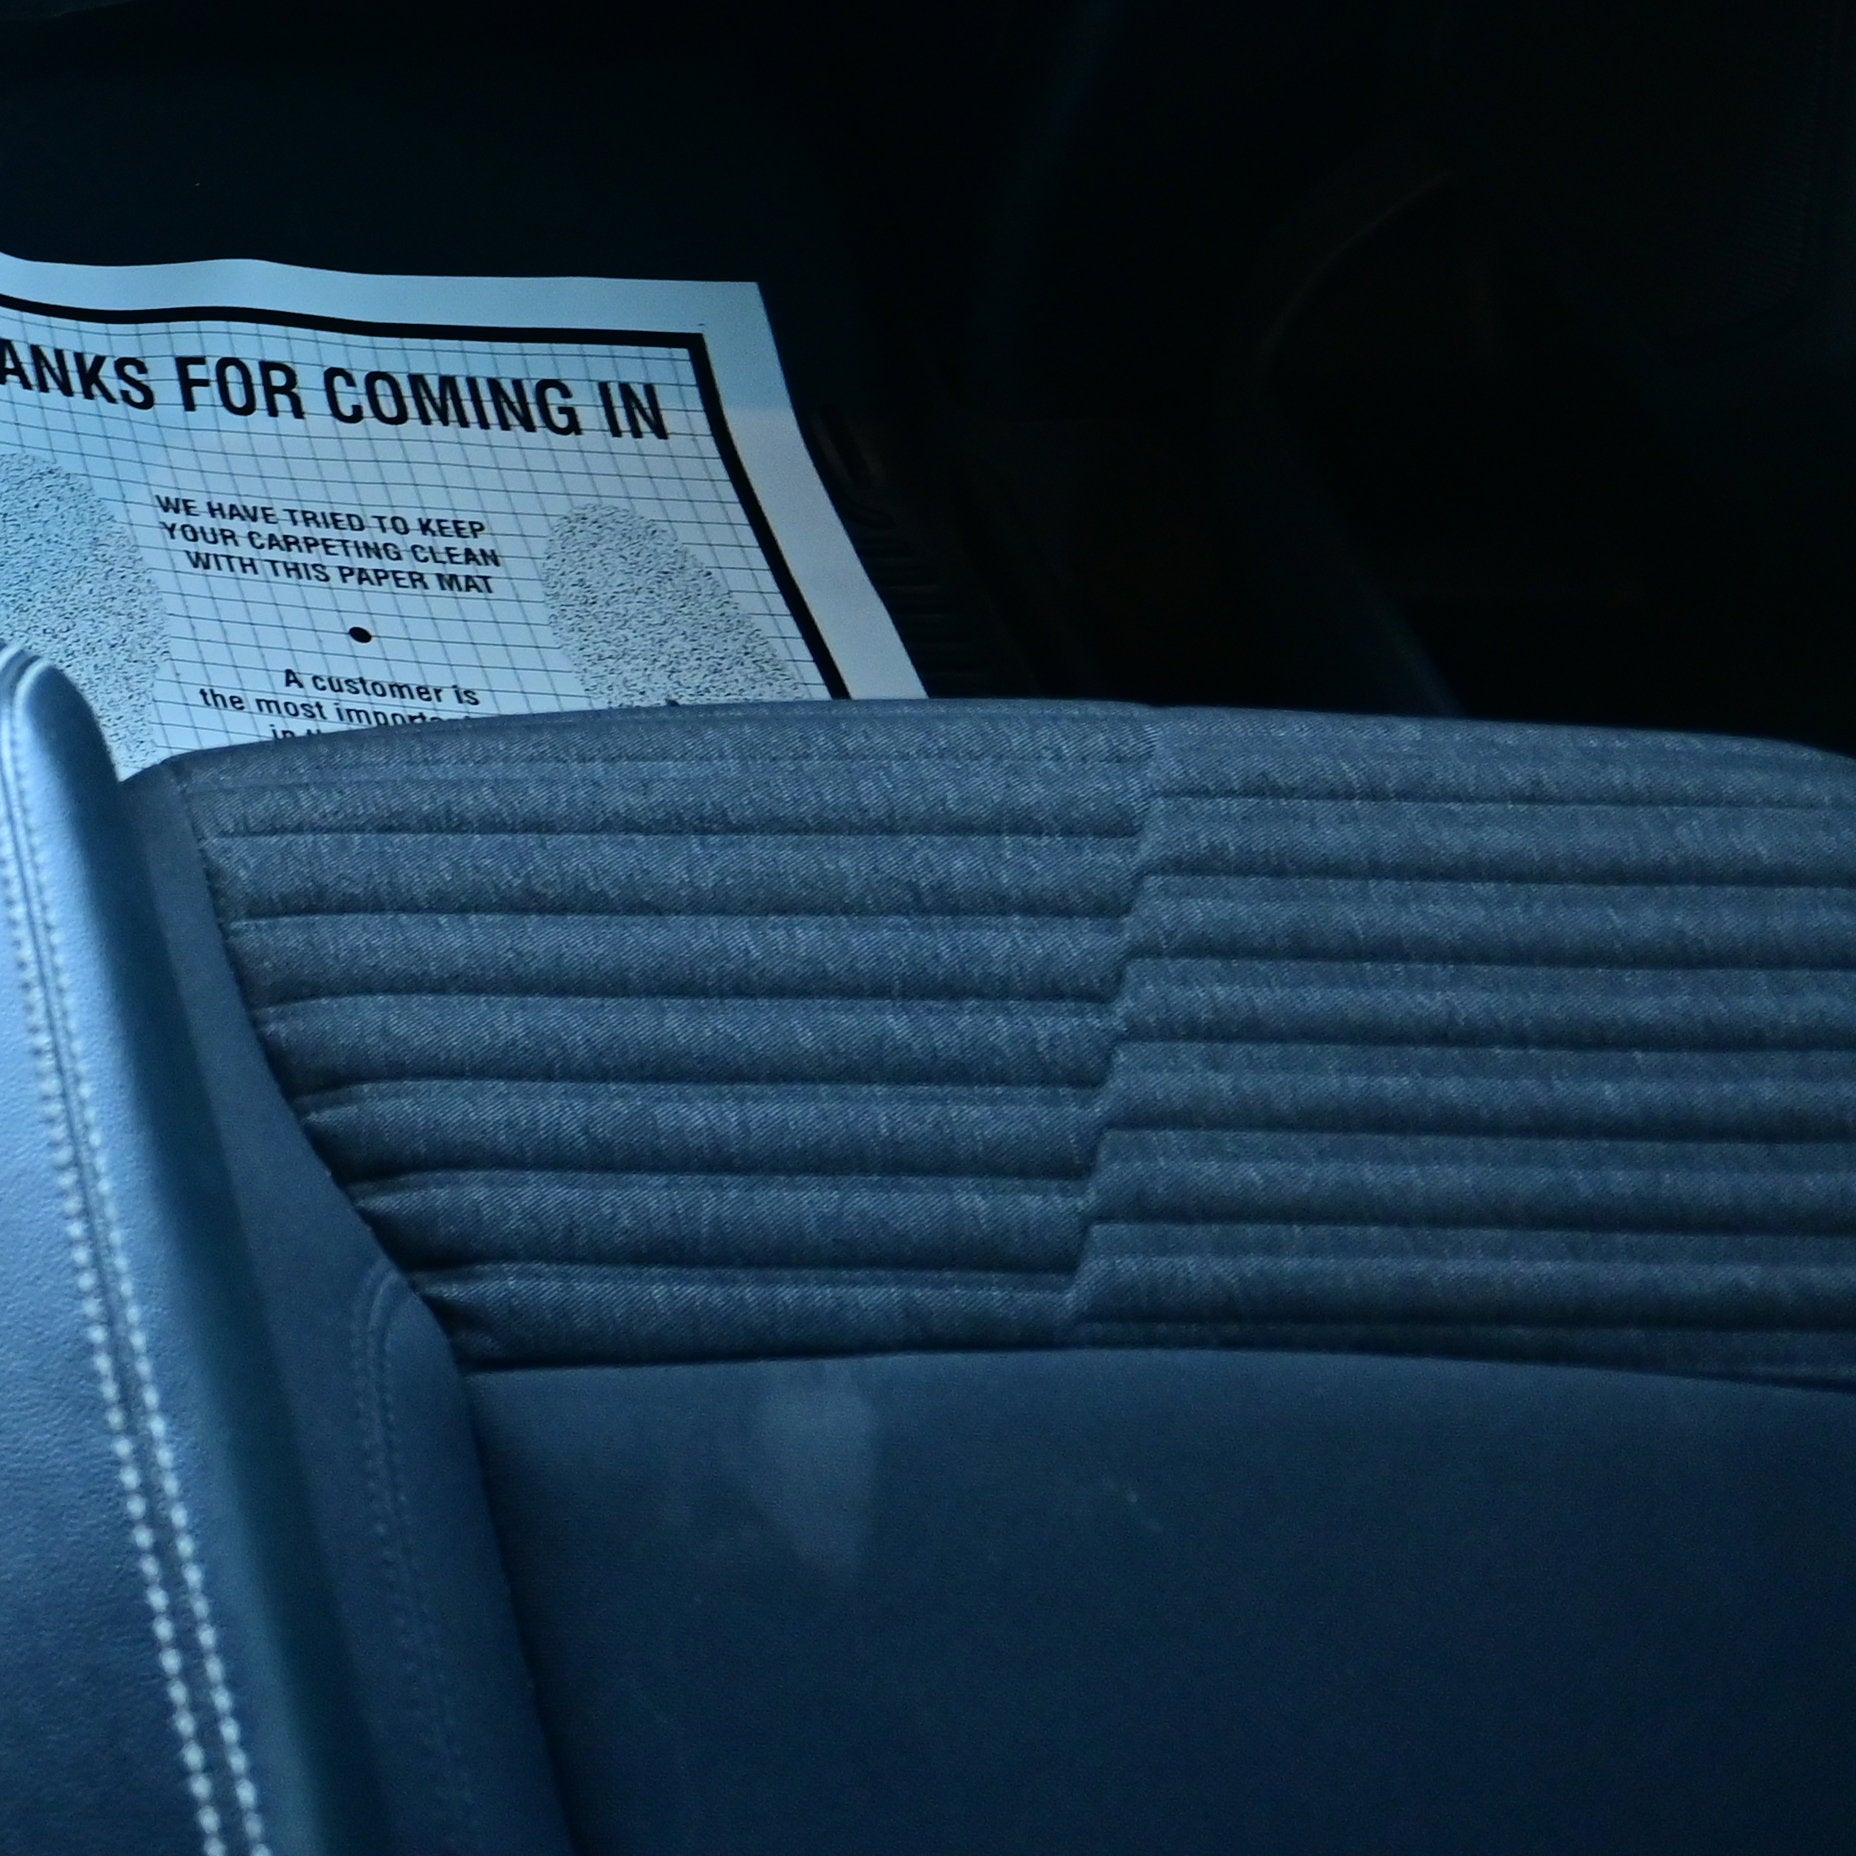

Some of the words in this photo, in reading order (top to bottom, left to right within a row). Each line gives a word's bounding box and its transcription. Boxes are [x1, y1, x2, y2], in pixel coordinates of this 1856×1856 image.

[175, 354, 304, 420] FOR
[322, 365, 582, 437] COMING
[597, 380, 668, 440] IN
[155, 494, 199, 516] WE
[207, 500, 278, 524] HAVE
[283, 508, 365, 532] TRIED
[370, 515, 410, 536] TO
[417, 517, 486, 539] KEEP
[159, 521, 240, 546] YOUR
[247, 530, 402, 562] CARPETING
[410, 544, 501, 567] CLEAN
[184, 549, 258, 575] WITH
[264, 558, 329, 582] THIS
[337, 565, 428, 590] PAPER
[435, 572, 494, 594] MAT
[200, 687, 244, 711] the
[256, 696, 327, 720] most
[284, 668, 304, 689] A
[312, 675, 442, 703] customer
[453, 684, 480, 706] is
